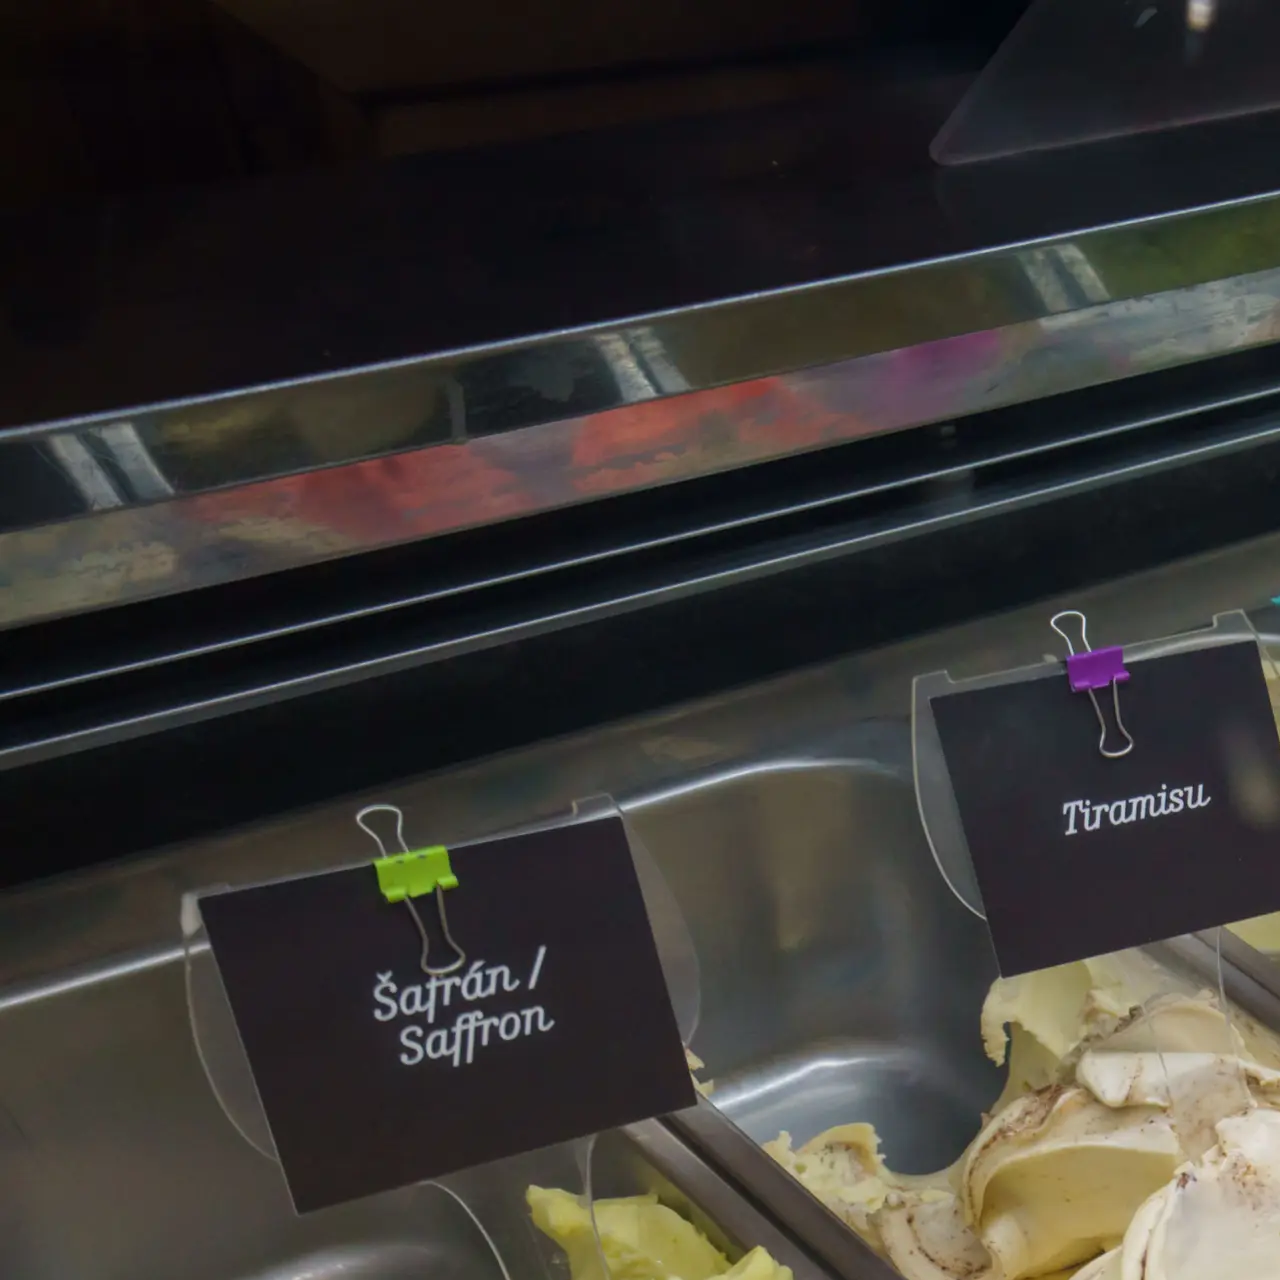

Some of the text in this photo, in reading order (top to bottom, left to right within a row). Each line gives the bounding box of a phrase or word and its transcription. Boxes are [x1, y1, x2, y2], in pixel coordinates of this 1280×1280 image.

[1063, 782, 1212, 836] Tiramisu
[372, 945, 547, 1023] Šafrán /
[399, 1004, 556, 1067] Saffron
